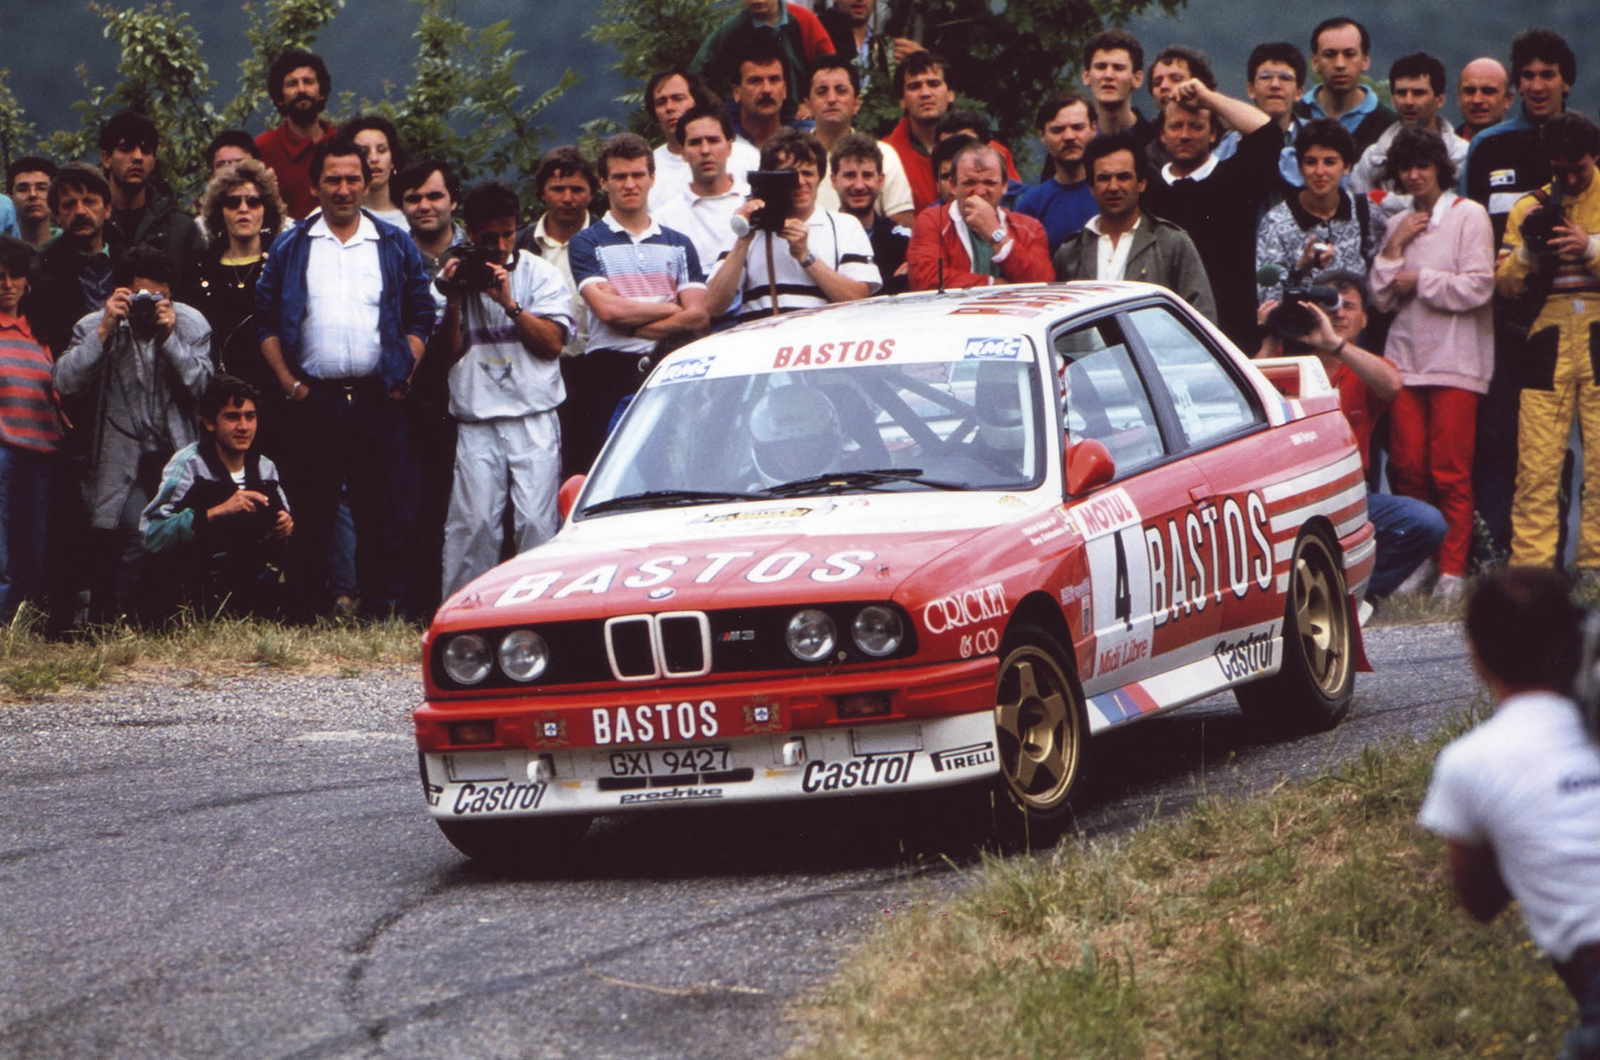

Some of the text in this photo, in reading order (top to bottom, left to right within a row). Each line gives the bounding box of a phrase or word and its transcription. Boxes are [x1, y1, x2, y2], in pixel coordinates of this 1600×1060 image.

[772, 338, 897, 369] BASTOS
[1079, 493, 1133, 535] MOTUL
[493, 549, 878, 609] BASTOS
[1144, 489, 1274, 630] BASTOS
[1113, 531, 1133, 631] 4
[923, 583, 1009, 634] CRICKET
[976, 627, 999, 655] CO
[1213, 624, 1275, 682] Castrol
[592, 700, 719, 746] BASTOS
[609, 747, 730, 776] GXI 9427
[801, 751, 915, 794] Castrol
[930, 741, 997, 773] PIRELLI
[453, 781, 549, 815] Castrol
[620, 788, 724, 804] prodrive
